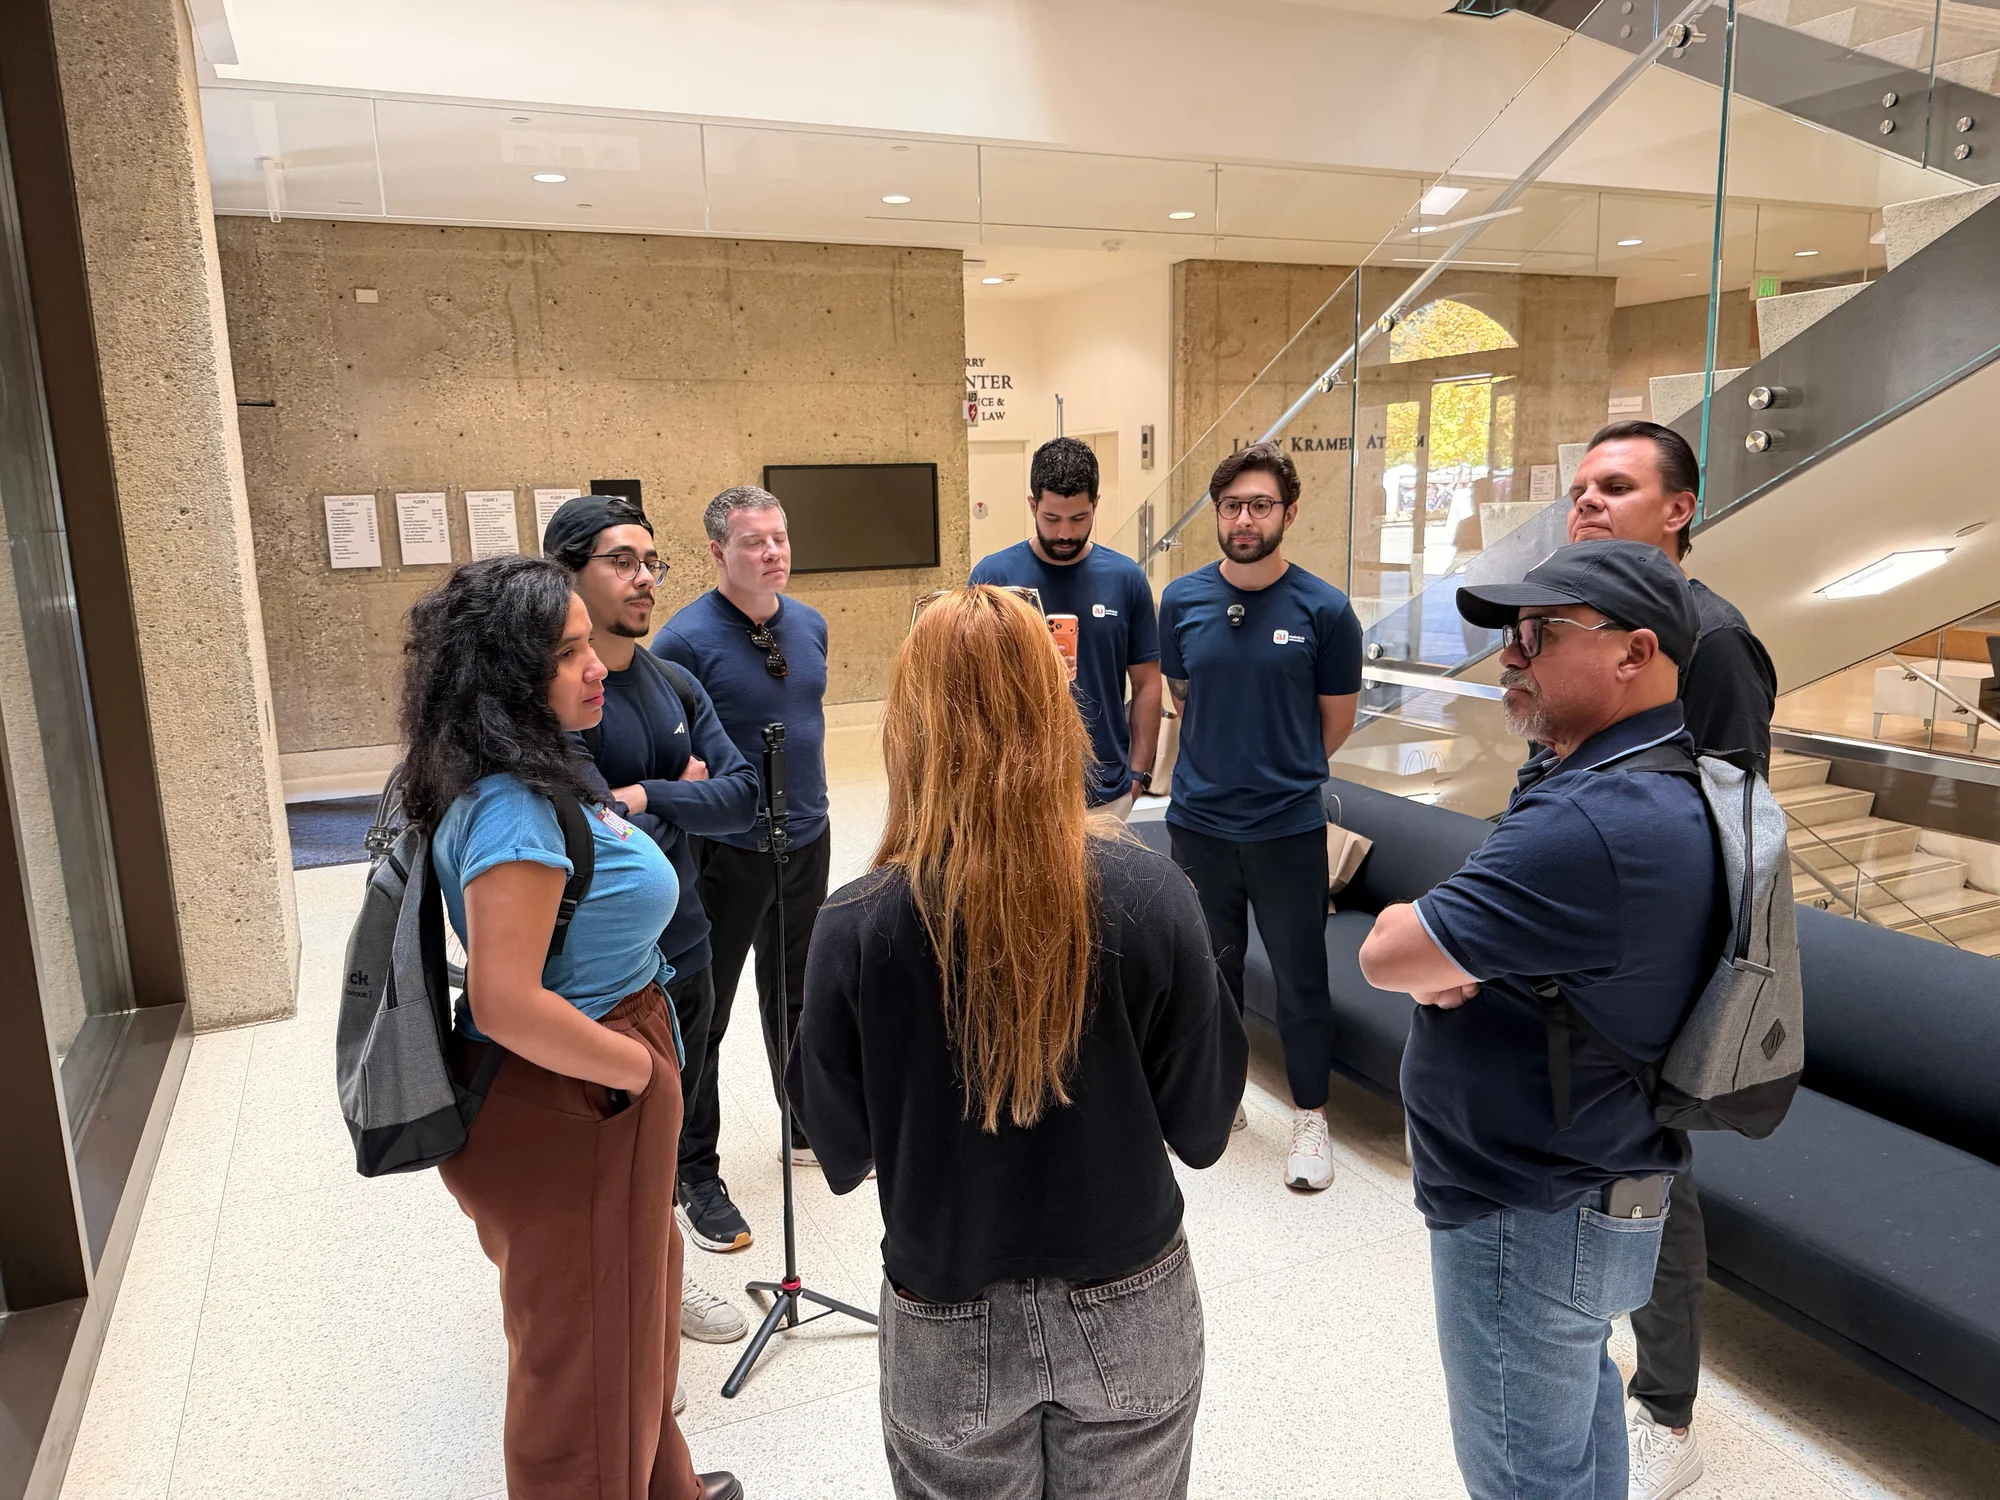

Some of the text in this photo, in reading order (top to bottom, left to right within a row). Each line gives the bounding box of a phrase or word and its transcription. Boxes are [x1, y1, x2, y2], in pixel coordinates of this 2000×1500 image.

[997, 398, 1005, 407] &
[982, 412, 1005, 421] LAW
[350, 970, 370, 986] ck
